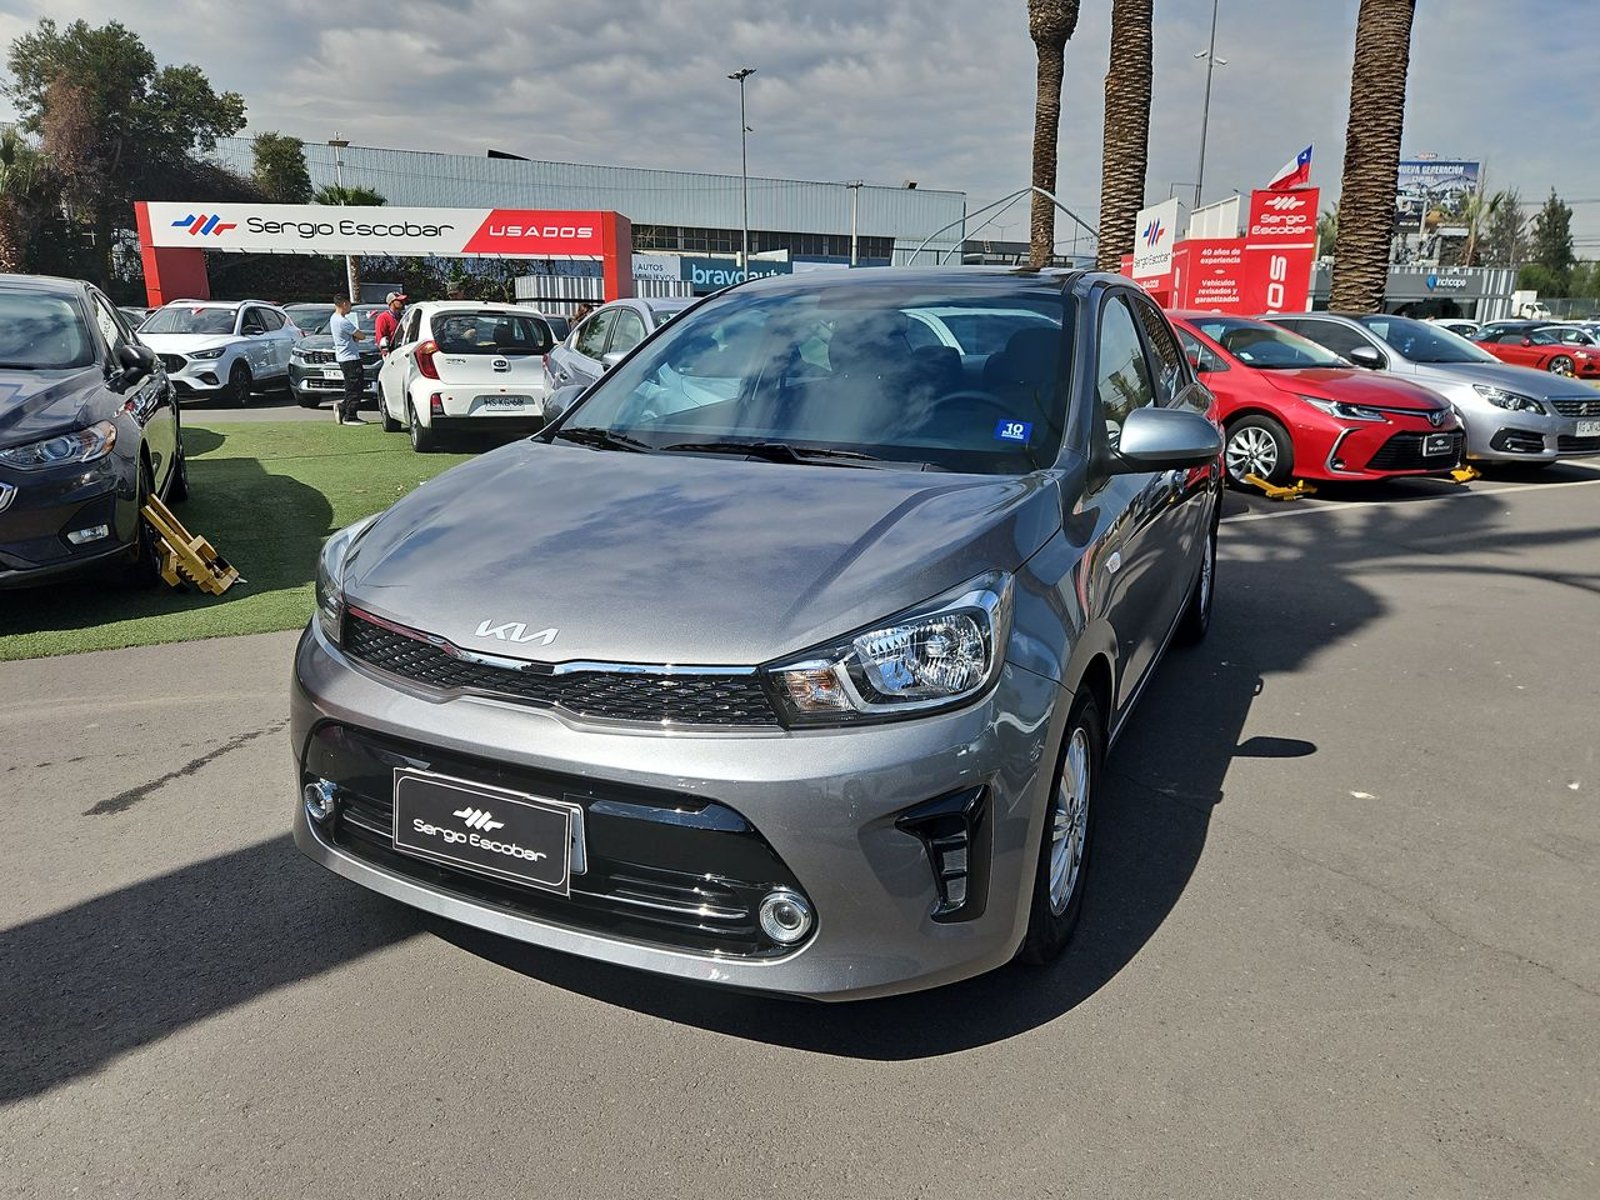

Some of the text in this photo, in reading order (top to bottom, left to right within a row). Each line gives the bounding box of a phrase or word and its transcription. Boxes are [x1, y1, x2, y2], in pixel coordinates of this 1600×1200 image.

[246, 217, 455, 239] Sergio Escobar
[489, 225, 593, 239] USADOS
[1251, 225, 1313, 235] Escobar
[1201, 248, 1241, 256] 40 años de
[1200, 256, 1241, 265] experiencia
[638, 263, 664, 271] AUTOS
[692, 263, 786, 285] bravoa
[1194, 296, 1240, 304] garantizados
[1006, 423, 1024, 433] 10
[412, 818, 547, 862] Sergio Escobar
